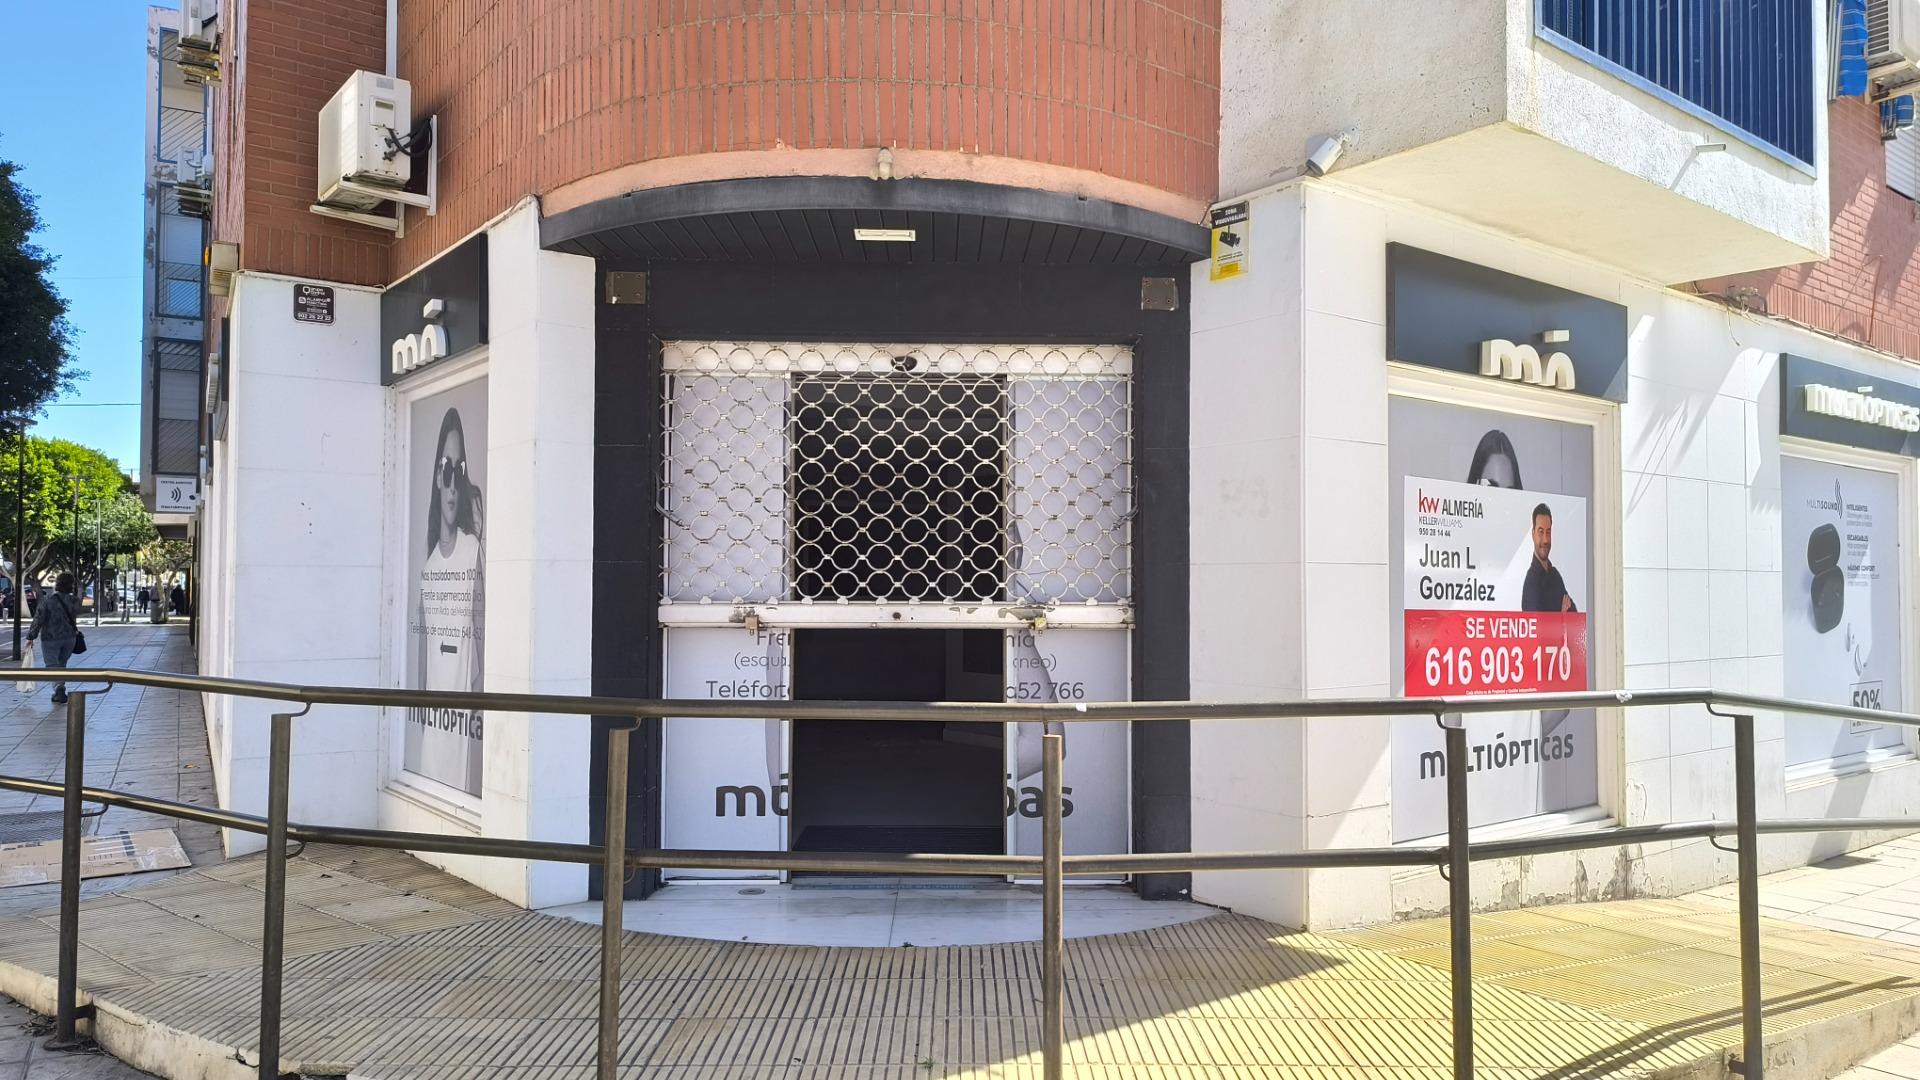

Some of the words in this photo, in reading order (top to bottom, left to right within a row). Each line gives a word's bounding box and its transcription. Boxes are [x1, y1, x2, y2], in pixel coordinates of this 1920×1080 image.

[1418, 488, 1440, 514] kw
[1442, 498, 1484, 519] ALMERÍA
[1419, 527, 1429, 536] 950
[1419, 543, 1461, 570] Juan
[1466, 547, 1476, 570] L
[1419, 575, 1496, 602] González
[1465, 617, 1486, 639] SE
[1489, 617, 1538, 639] VENDE
[1425, 646, 1473, 687] 616
[1480, 645, 1525, 685] 903
[1532, 644, 1572, 682] 170
[1047, 681, 1084, 700] 766
